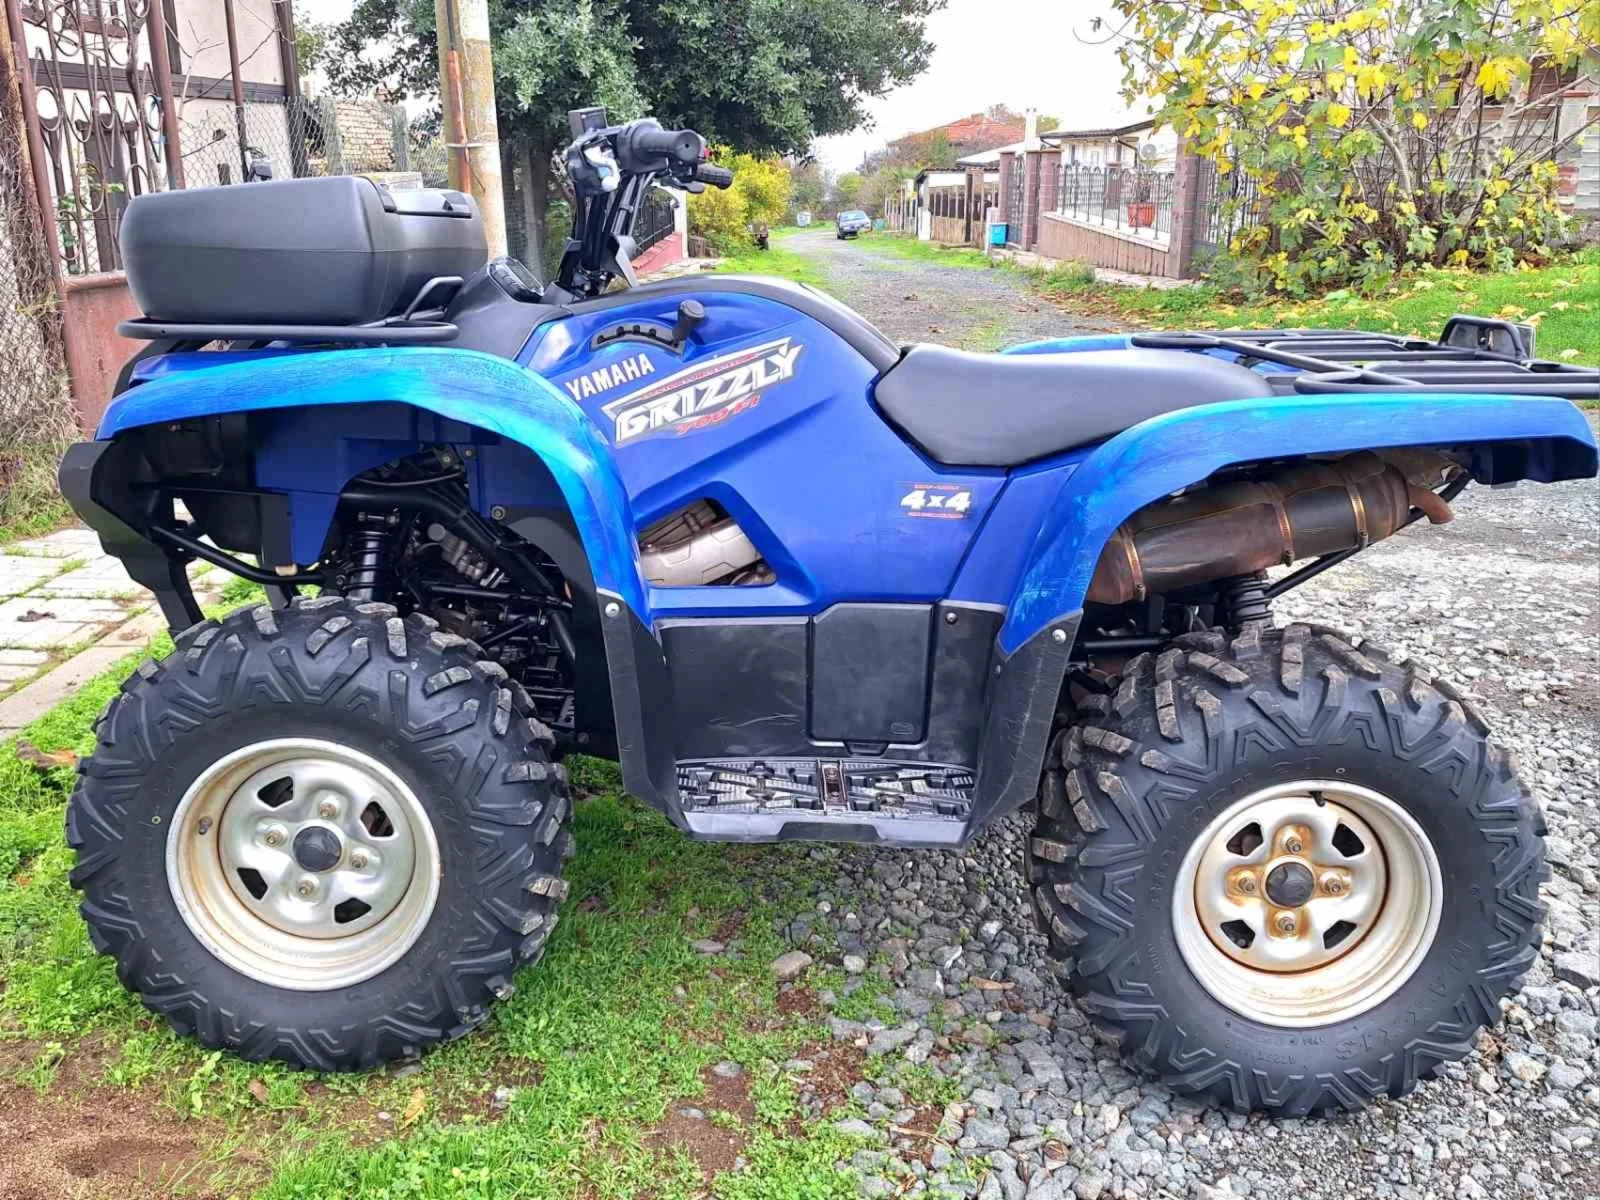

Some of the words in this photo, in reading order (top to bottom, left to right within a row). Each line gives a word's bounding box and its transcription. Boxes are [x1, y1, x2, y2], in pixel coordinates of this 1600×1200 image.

[565, 353, 655, 401] YAMAHA
[615, 344, 804, 443] GRIZZLY
[900, 490, 971, 513] 4x4
